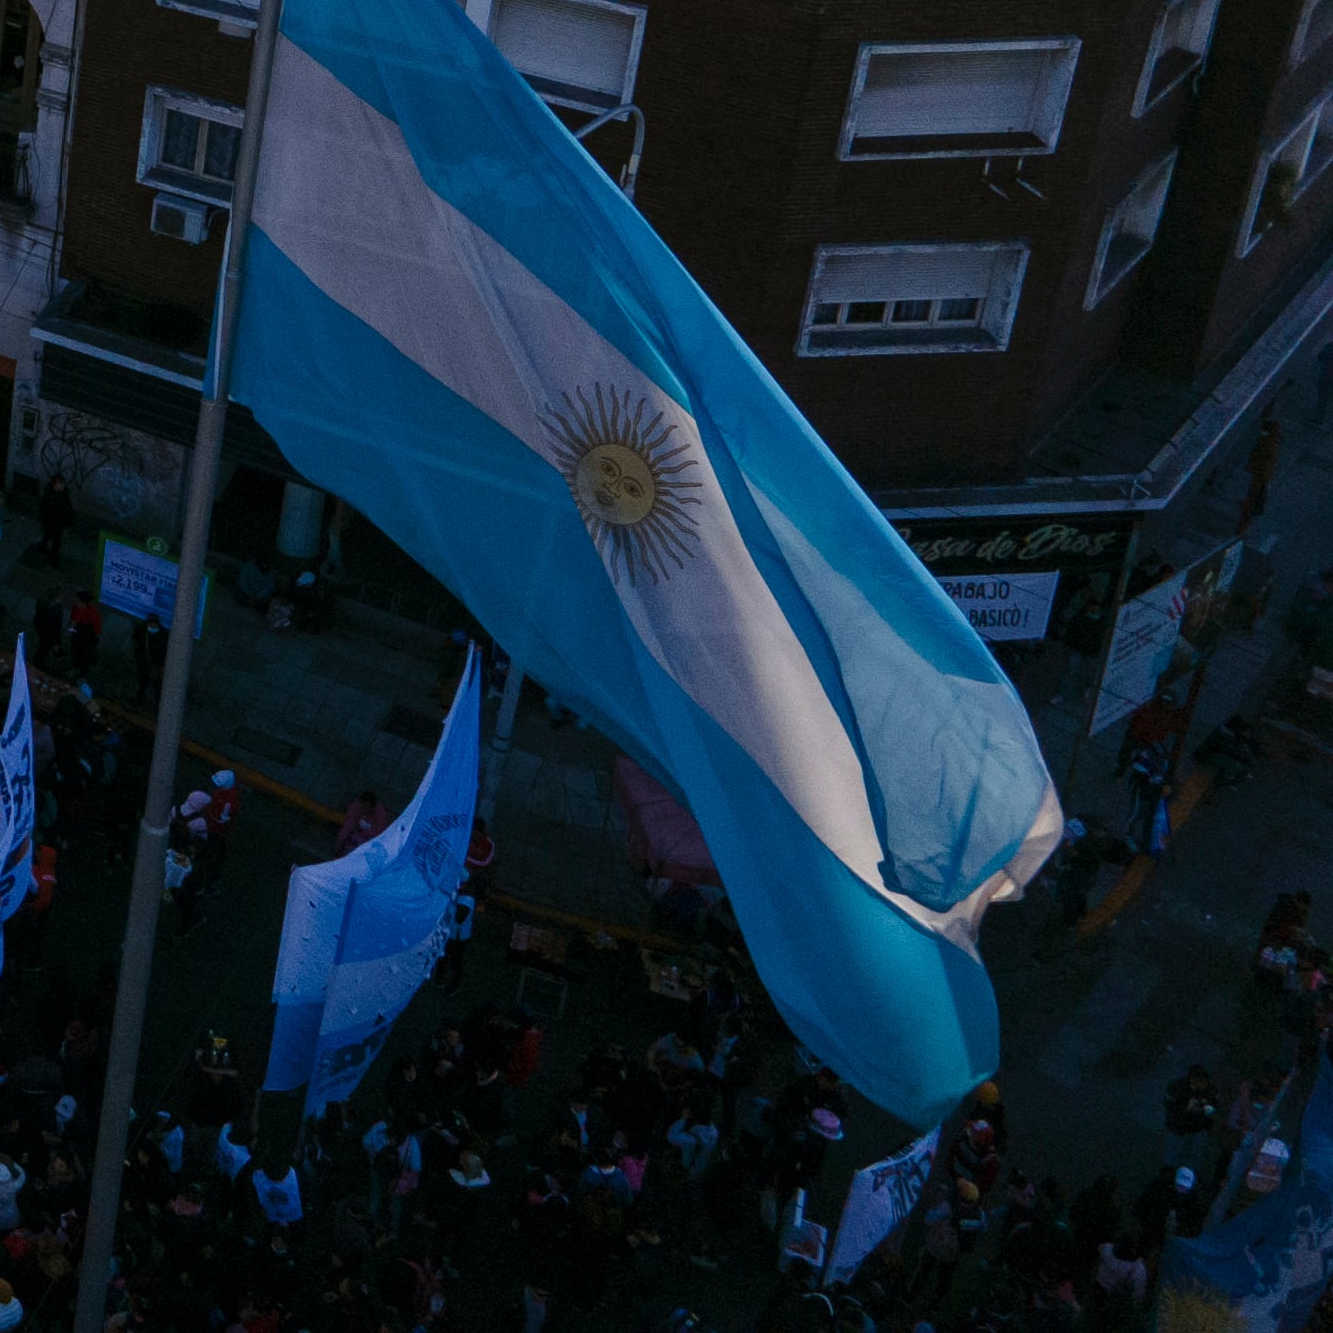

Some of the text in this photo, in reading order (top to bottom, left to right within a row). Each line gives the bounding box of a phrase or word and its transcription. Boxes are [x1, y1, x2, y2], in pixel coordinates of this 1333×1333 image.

[976, 530, 1015, 563] de
[1017, 524, 1120, 562] Dios
[111, 560, 157, 582] MOVISTAR
[944, 581, 1010, 600] RABAJO
